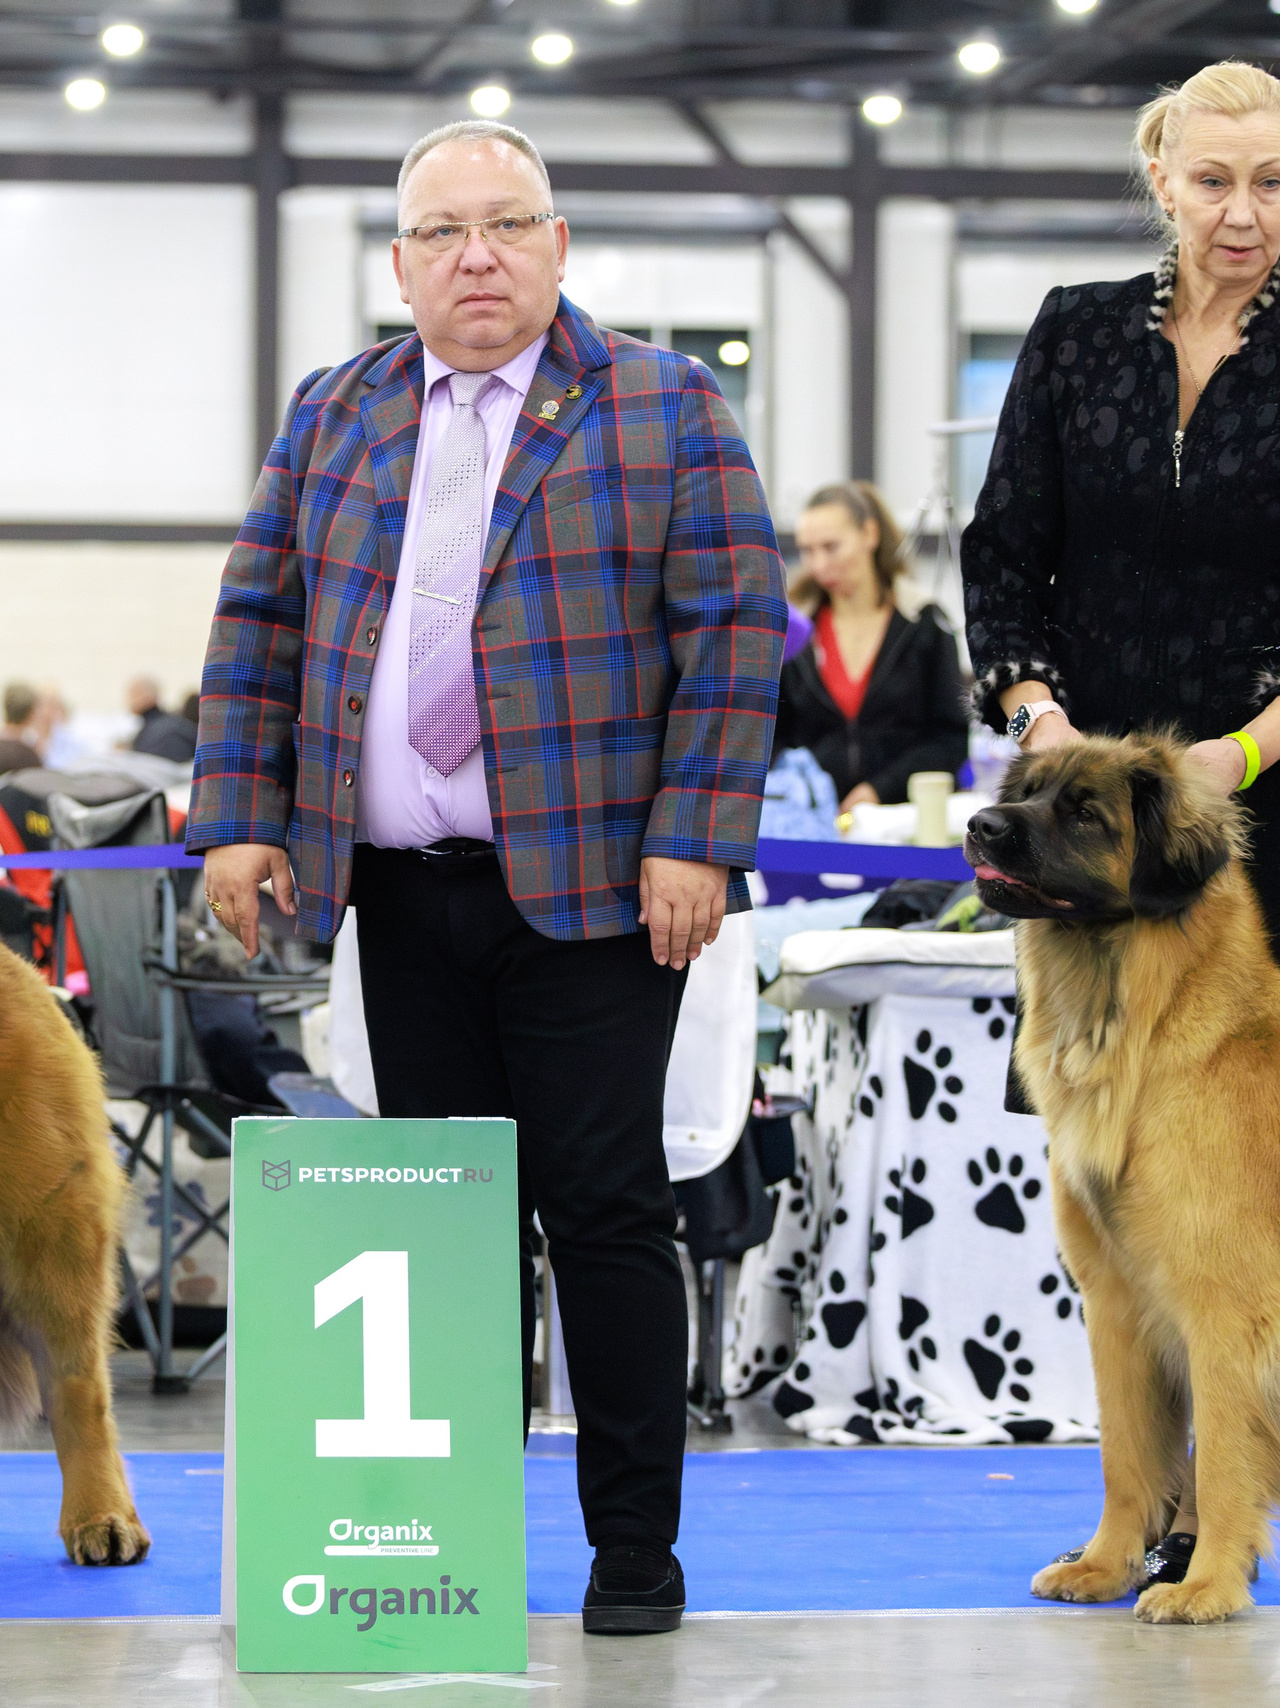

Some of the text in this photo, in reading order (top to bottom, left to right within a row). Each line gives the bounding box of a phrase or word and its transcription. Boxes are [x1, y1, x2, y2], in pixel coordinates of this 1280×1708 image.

[314, 1250, 451, 1457] 1
[329, 1518, 433, 1550] Organix
[282, 1574, 480, 1632] Organix
